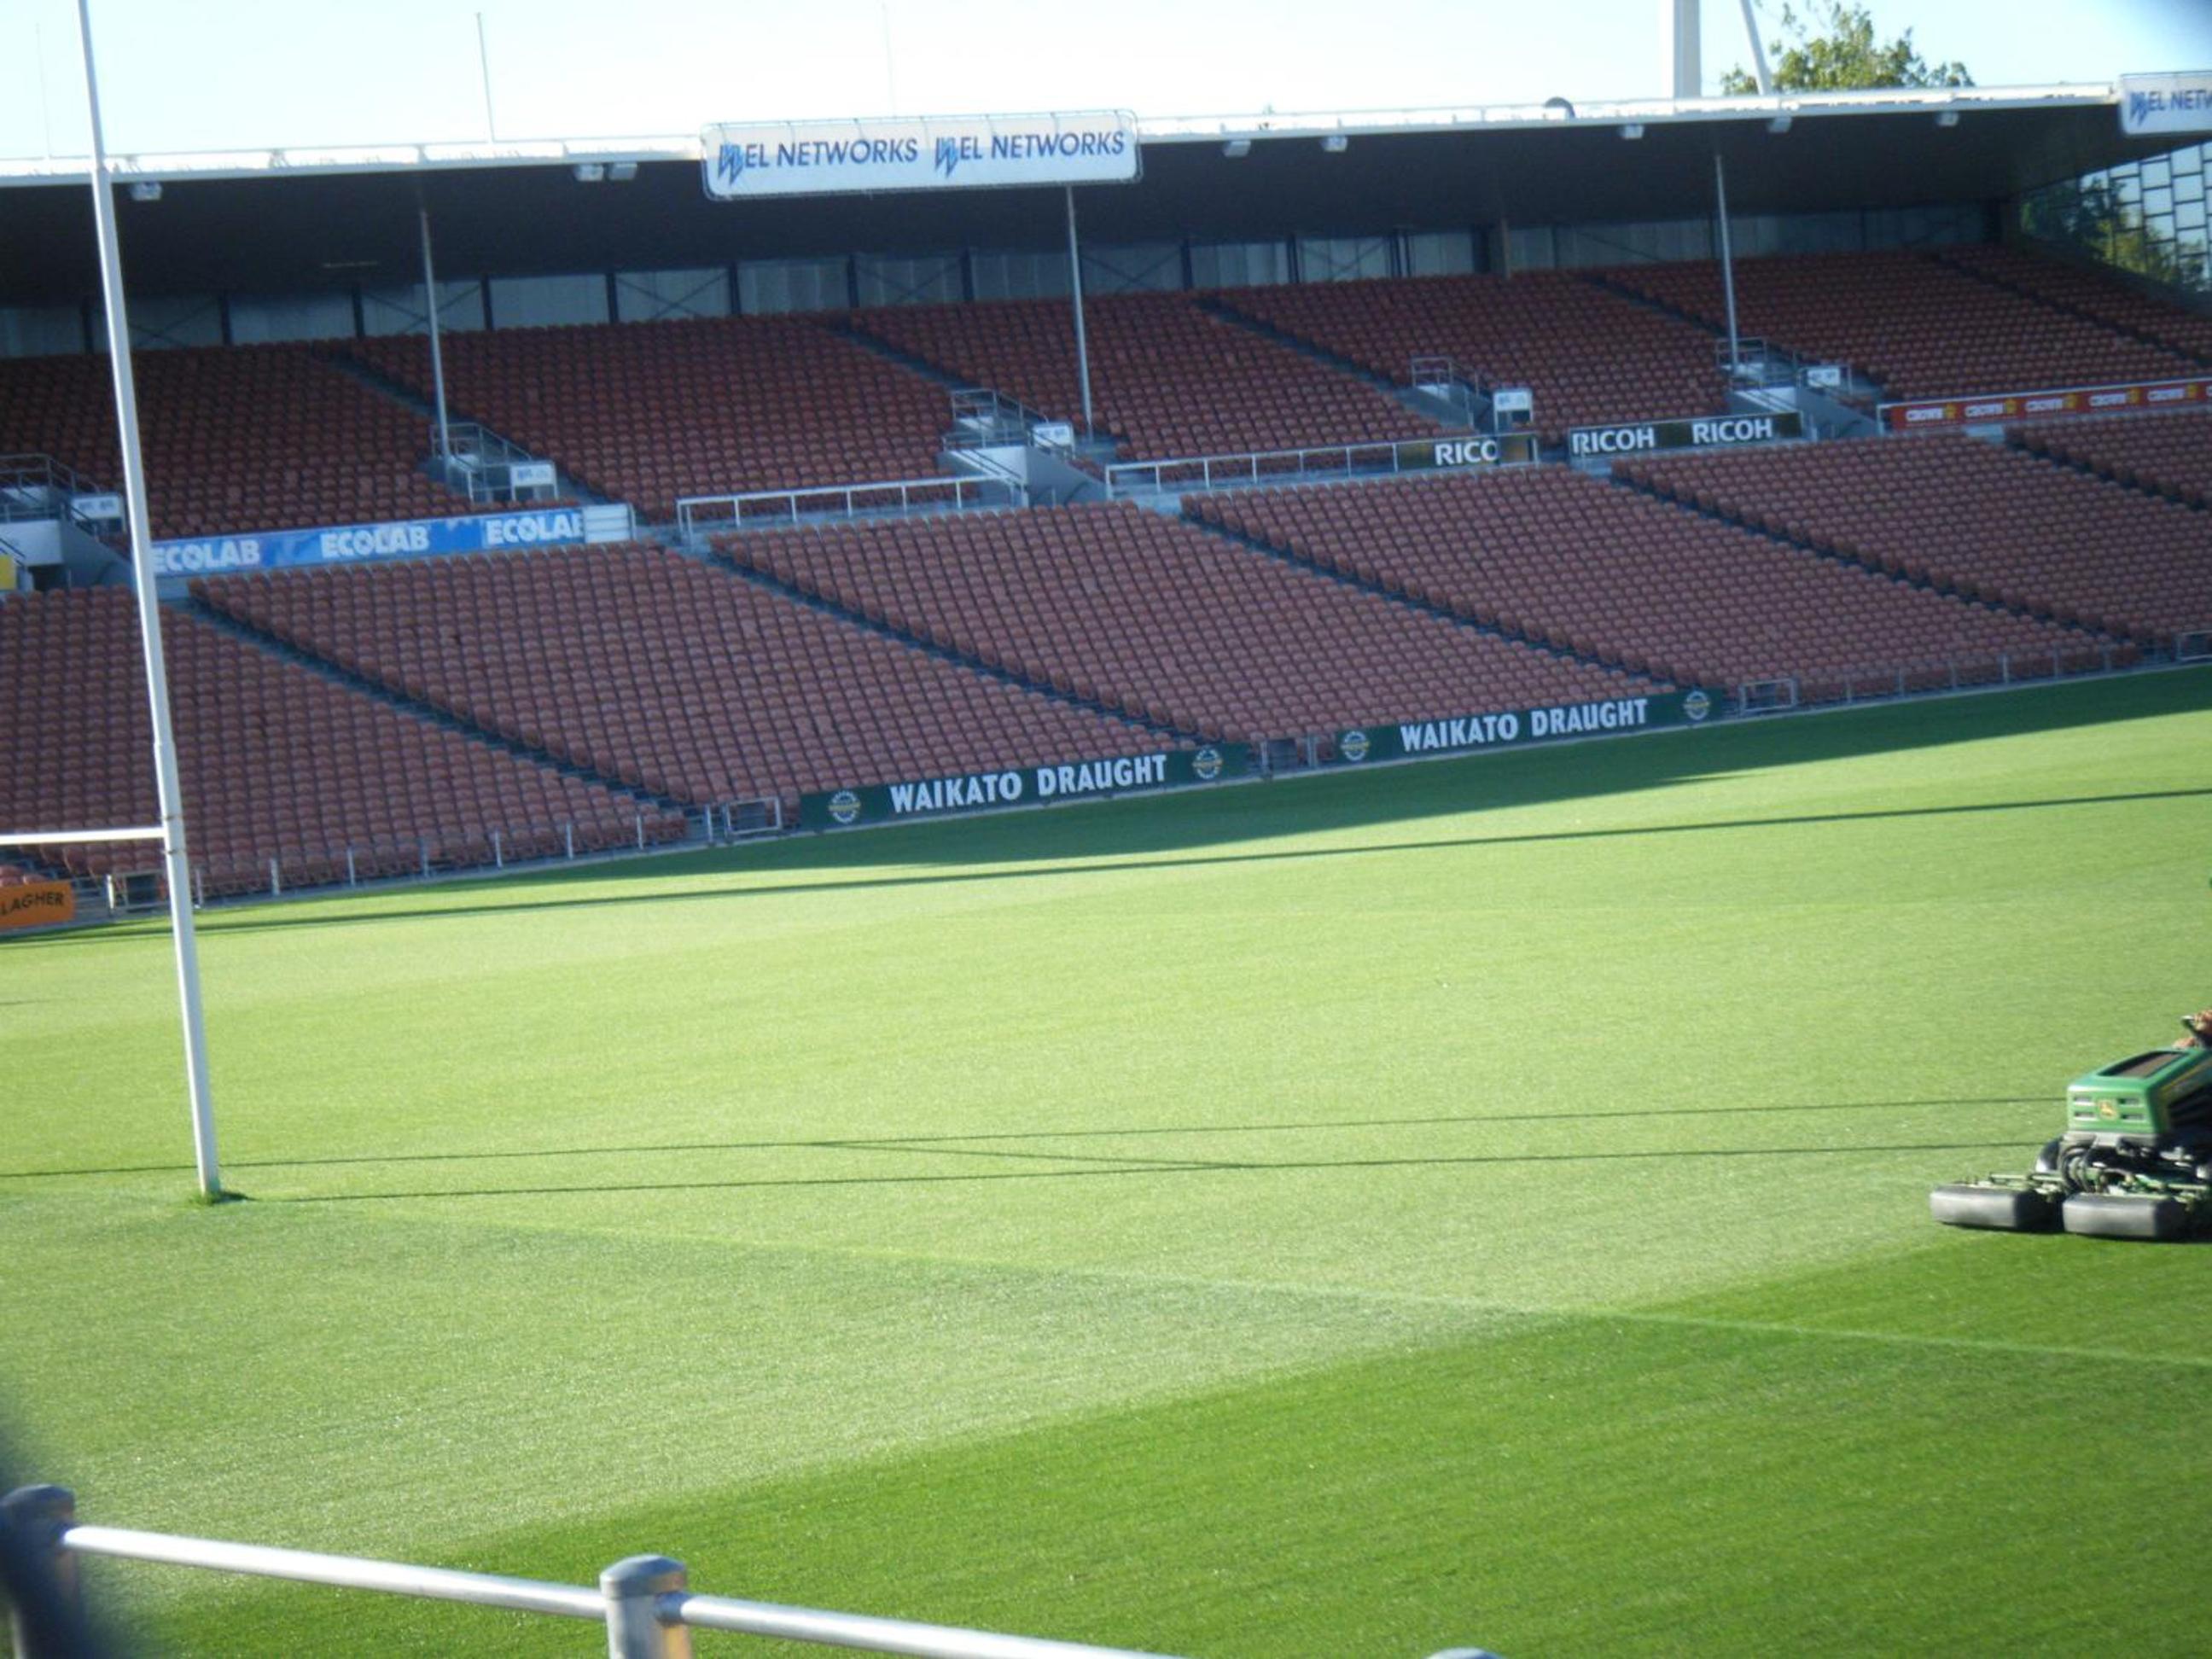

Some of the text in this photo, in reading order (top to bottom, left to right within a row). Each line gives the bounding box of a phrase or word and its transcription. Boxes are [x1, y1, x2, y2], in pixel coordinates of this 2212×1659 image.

[777, 138, 918, 167] NETWORKS
[991, 131, 1125, 159] NETWORKS
[1572, 427, 1656, 455] RICOH
[1692, 418, 1773, 445] RICOH
[320, 525, 430, 559] ECOLAB
[1400, 713, 1519, 752] WAIKATO
[1531, 698, 1648, 736] DRAUGHT
[890, 771, 1022, 812] WAIKATO
[1037, 754, 1167, 797] DRAUGHT
